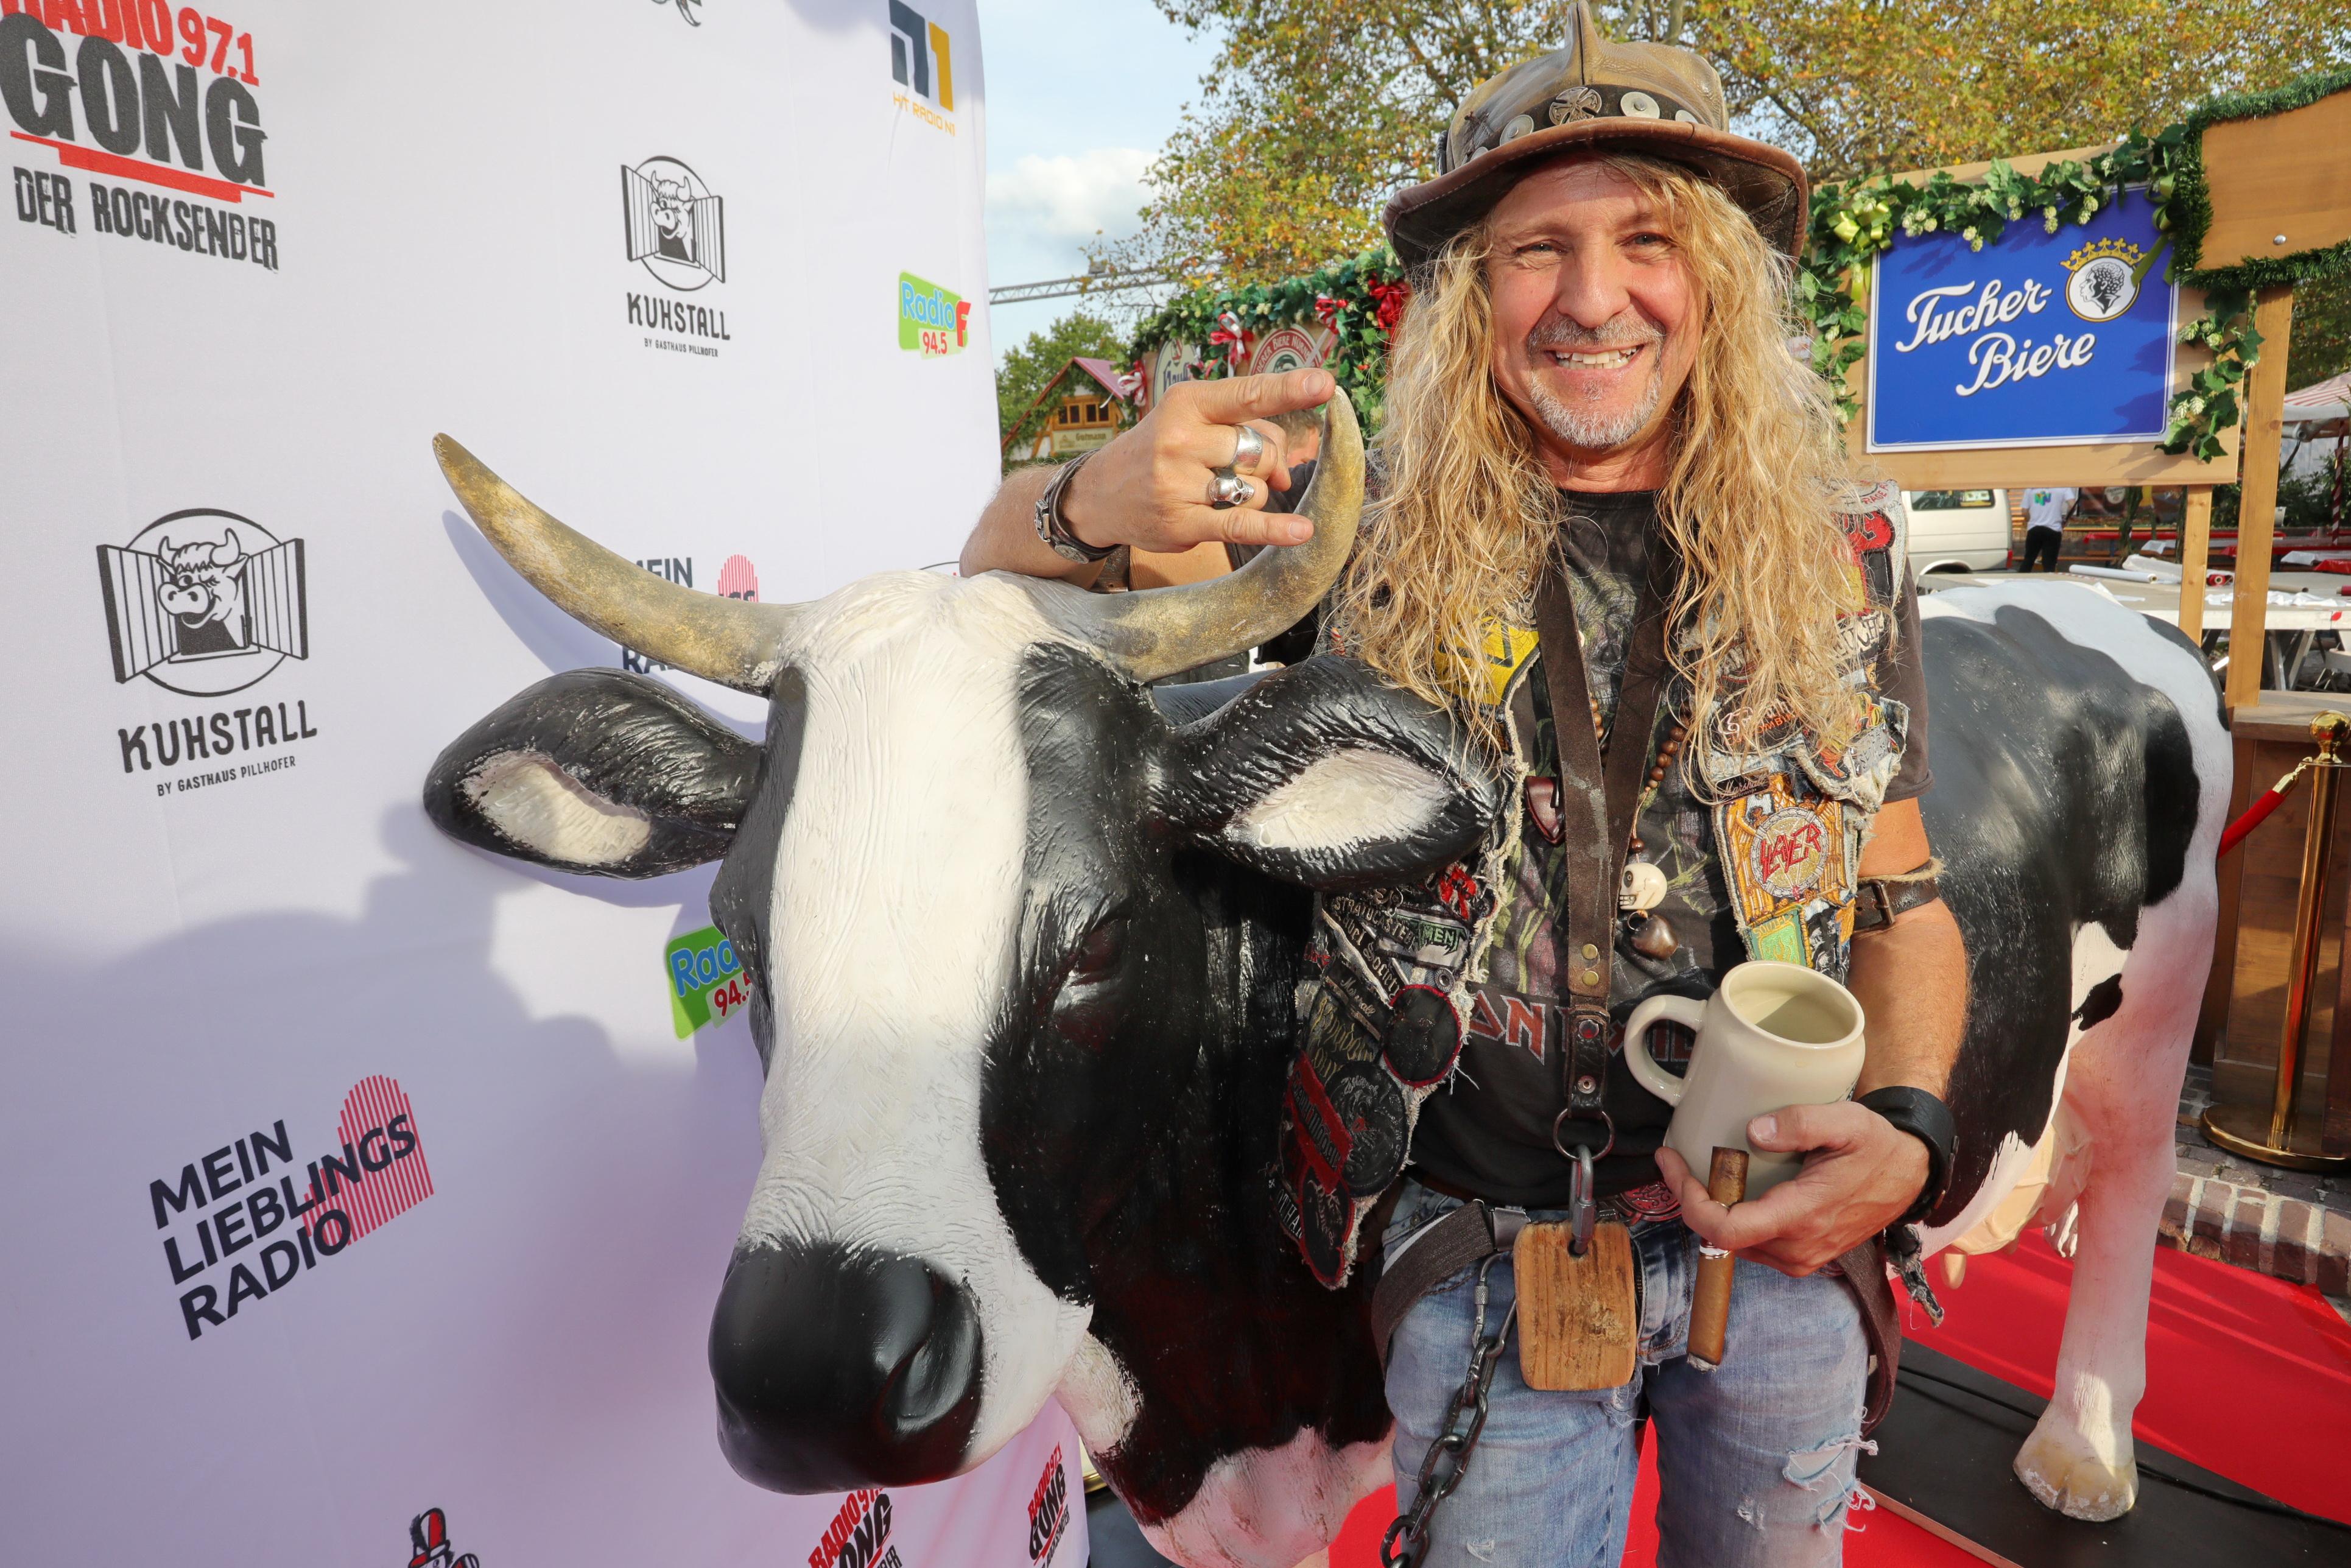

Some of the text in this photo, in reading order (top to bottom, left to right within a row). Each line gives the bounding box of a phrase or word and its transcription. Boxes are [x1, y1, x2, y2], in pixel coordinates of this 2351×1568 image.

[178, 7, 260, 86] 97.1
[0, 12, 269, 188] GONG
[893, 91, 910, 112] HIT
[913, 102, 943, 130] RADIO
[13, 166, 279, 272] DER ROCKSENDER
[627, 292, 731, 341] KUHSTALL
[901, 281, 955, 330] Radio
[922, 331, 947, 355] 94.5
[644, 337, 719, 358] BY GASTHAUS PILLHOFER
[1955, 332, 2096, 397] Biere
[118, 700, 318, 774] KUHSTALL
[156, 755, 296, 797] BY GASTHAUS PILLHOFER
[150, 1119, 293, 1230] MEIN
[163, 1113, 416, 1285] LIEBLINGS
[179, 1208, 351, 1341] RADIO
[808, 1492, 861, 1568] RADIO
[839, 1493, 893, 1568] ONG
[1029, 1463, 1066, 1560] GONG
